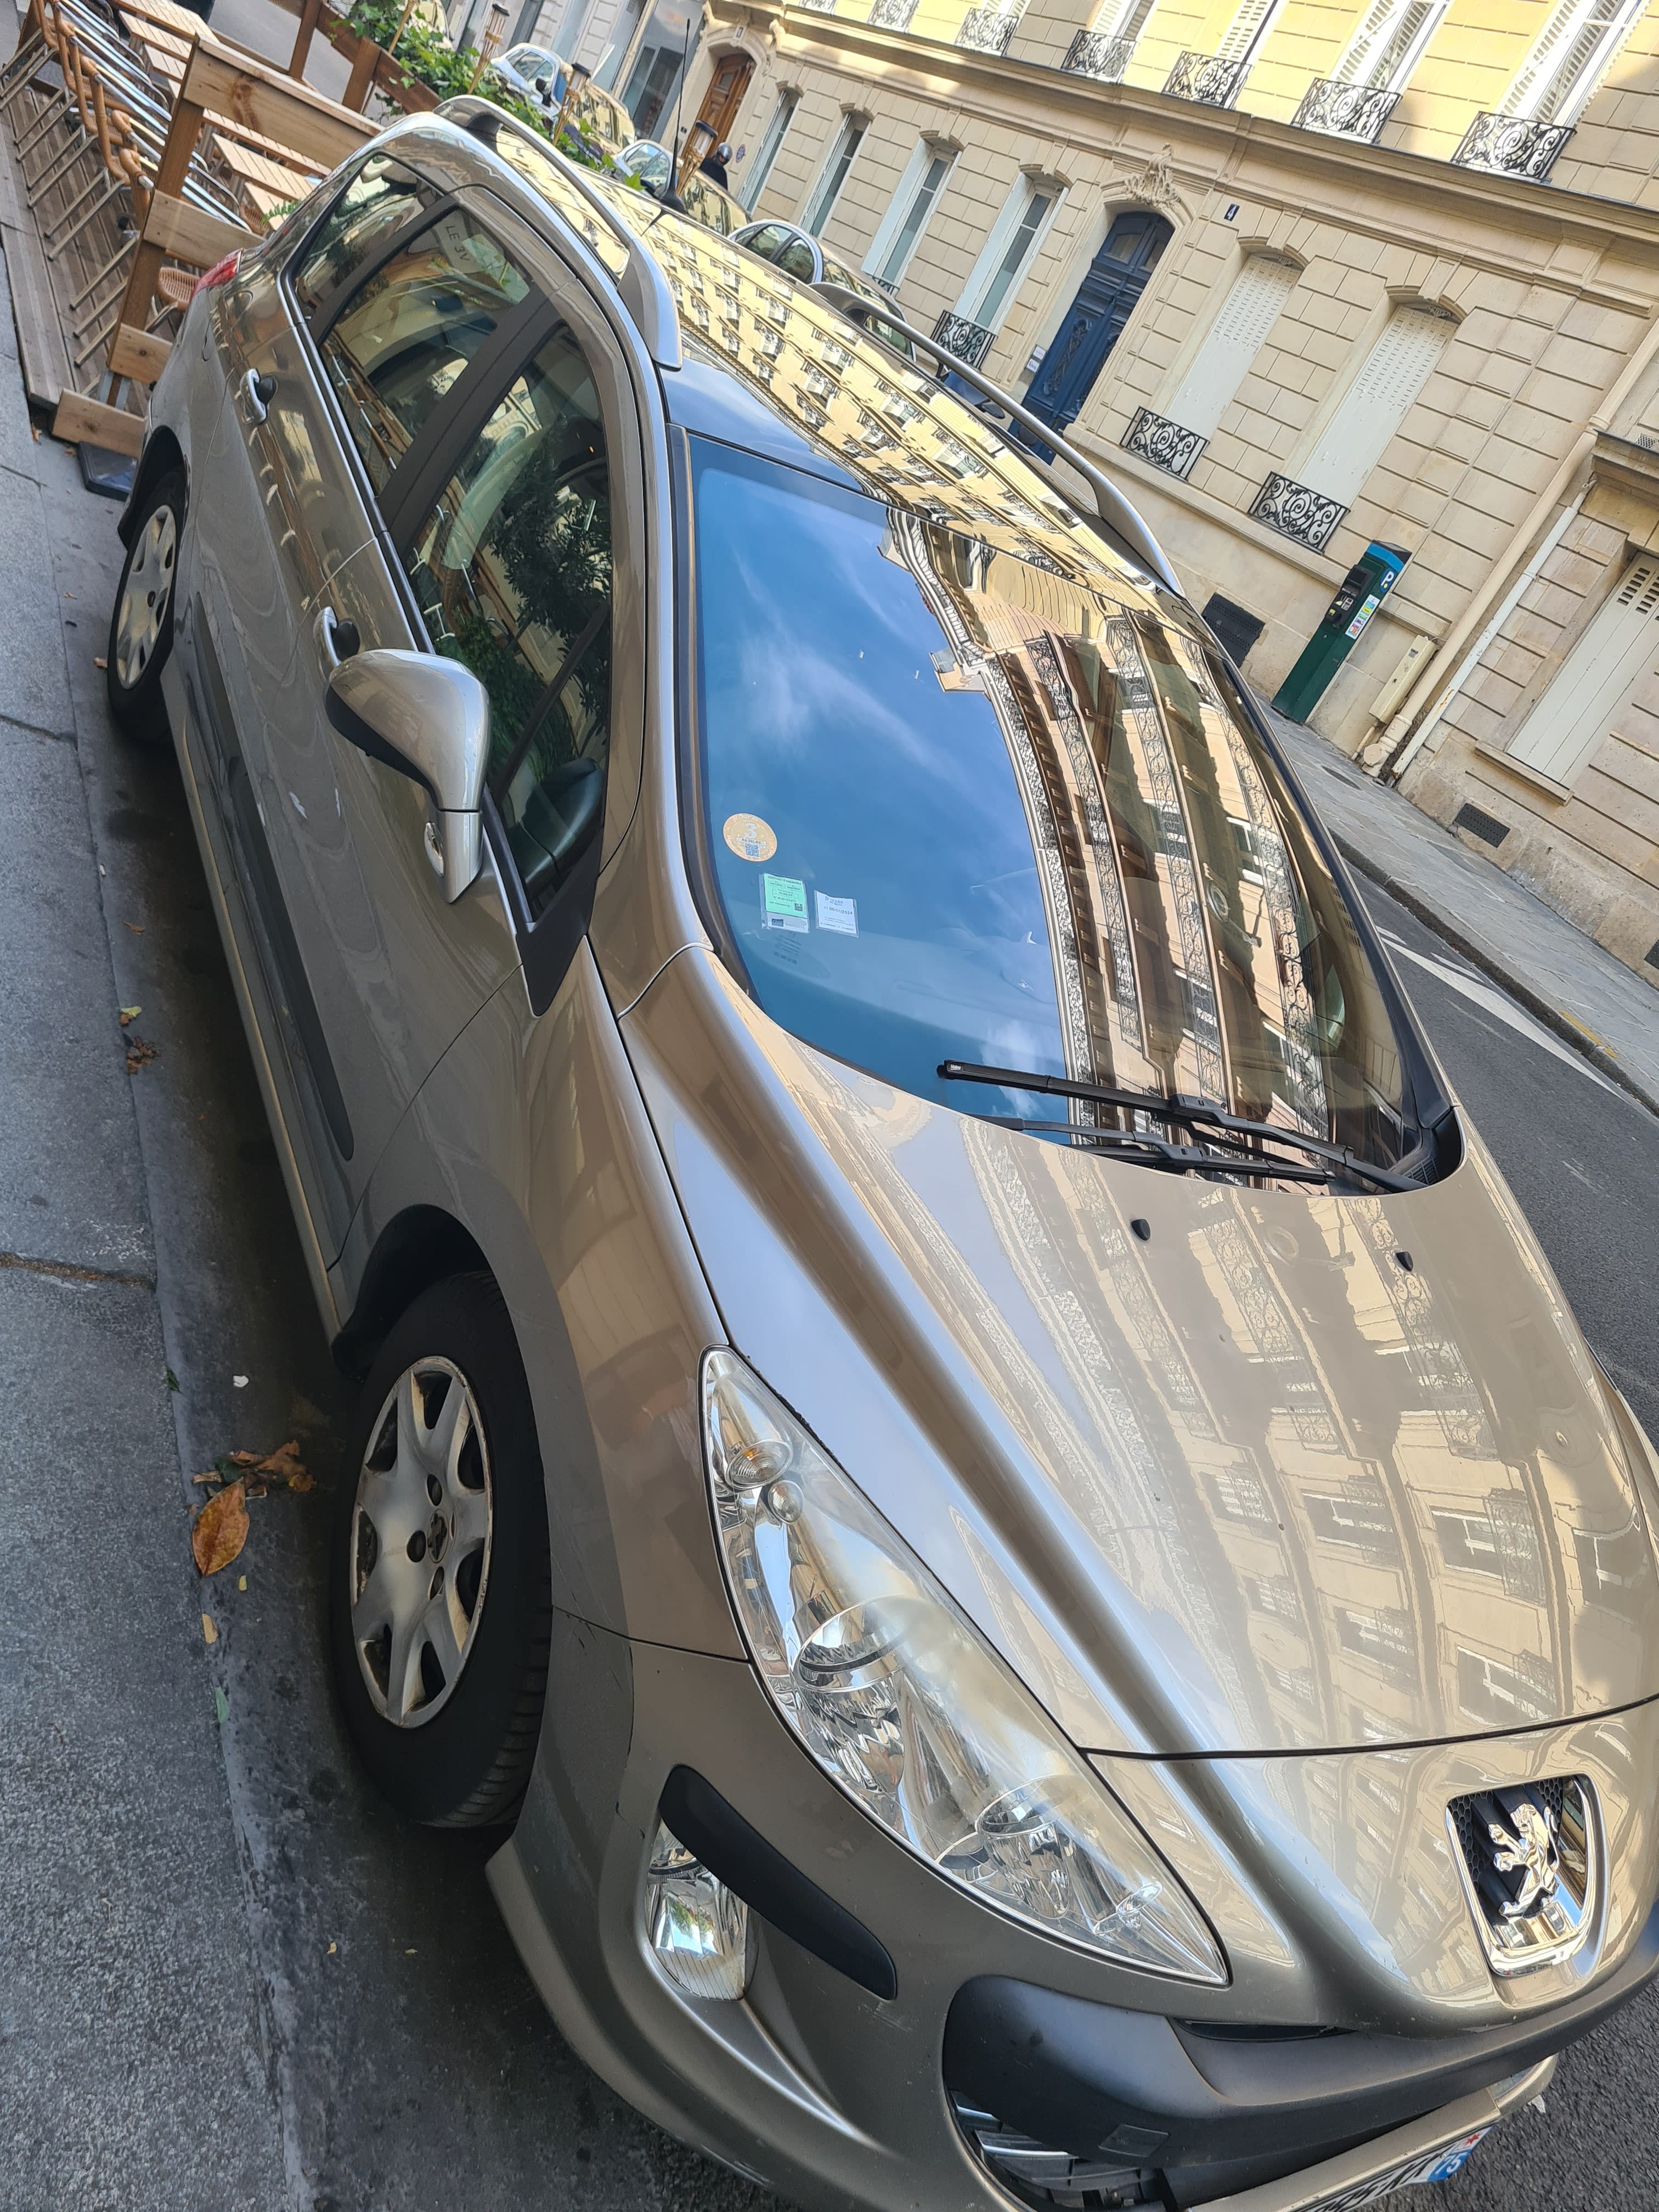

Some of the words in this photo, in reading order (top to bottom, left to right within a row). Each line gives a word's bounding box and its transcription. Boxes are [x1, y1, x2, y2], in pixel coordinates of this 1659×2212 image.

[1227, 205, 1238, 220] 4
[445, 225, 460, 241] LE
[1380, 571, 1395, 586] P
[744, 822, 757, 839] 3
[1435, 2152, 1468, 2175] 75
